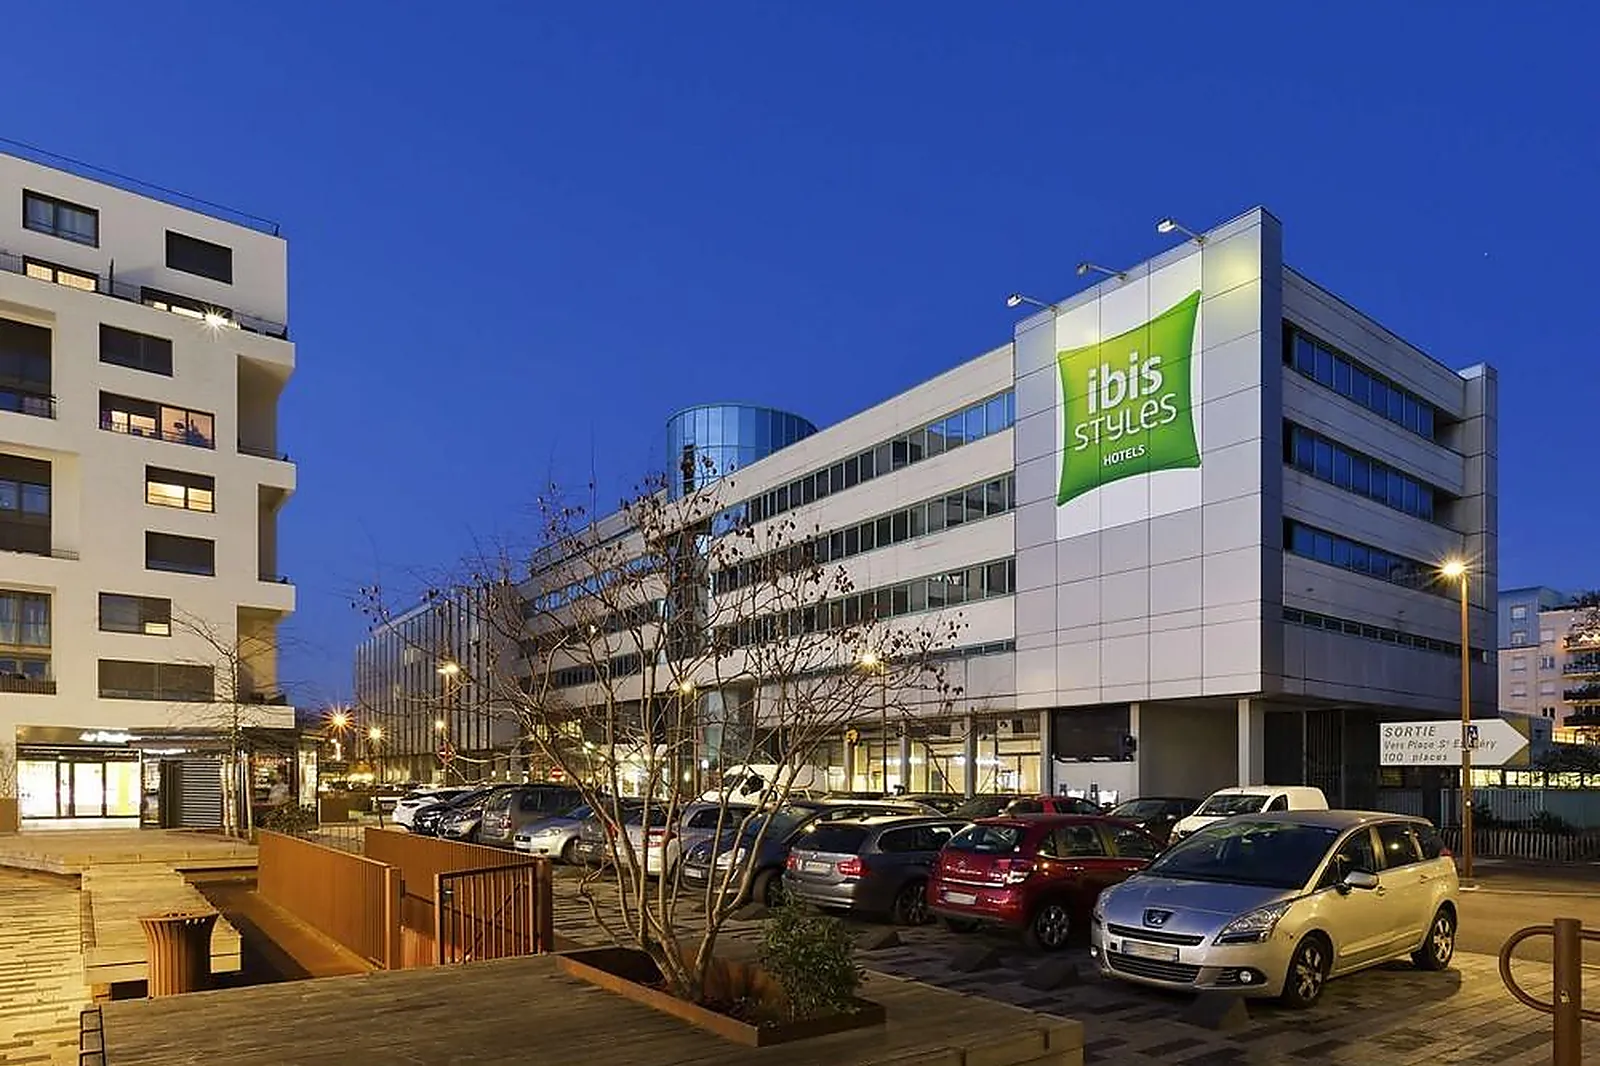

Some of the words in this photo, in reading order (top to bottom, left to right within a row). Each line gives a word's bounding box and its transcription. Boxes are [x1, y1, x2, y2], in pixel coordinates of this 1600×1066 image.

[1087, 350, 1163, 415] ibis
[1103, 444, 1146, 466] HOTELS
[1384, 726, 1436, 737] SORTIE
[1407, 740, 1434, 750] Place
[1384, 753, 1403, 762] 100
[1412, 753, 1447, 762] places
